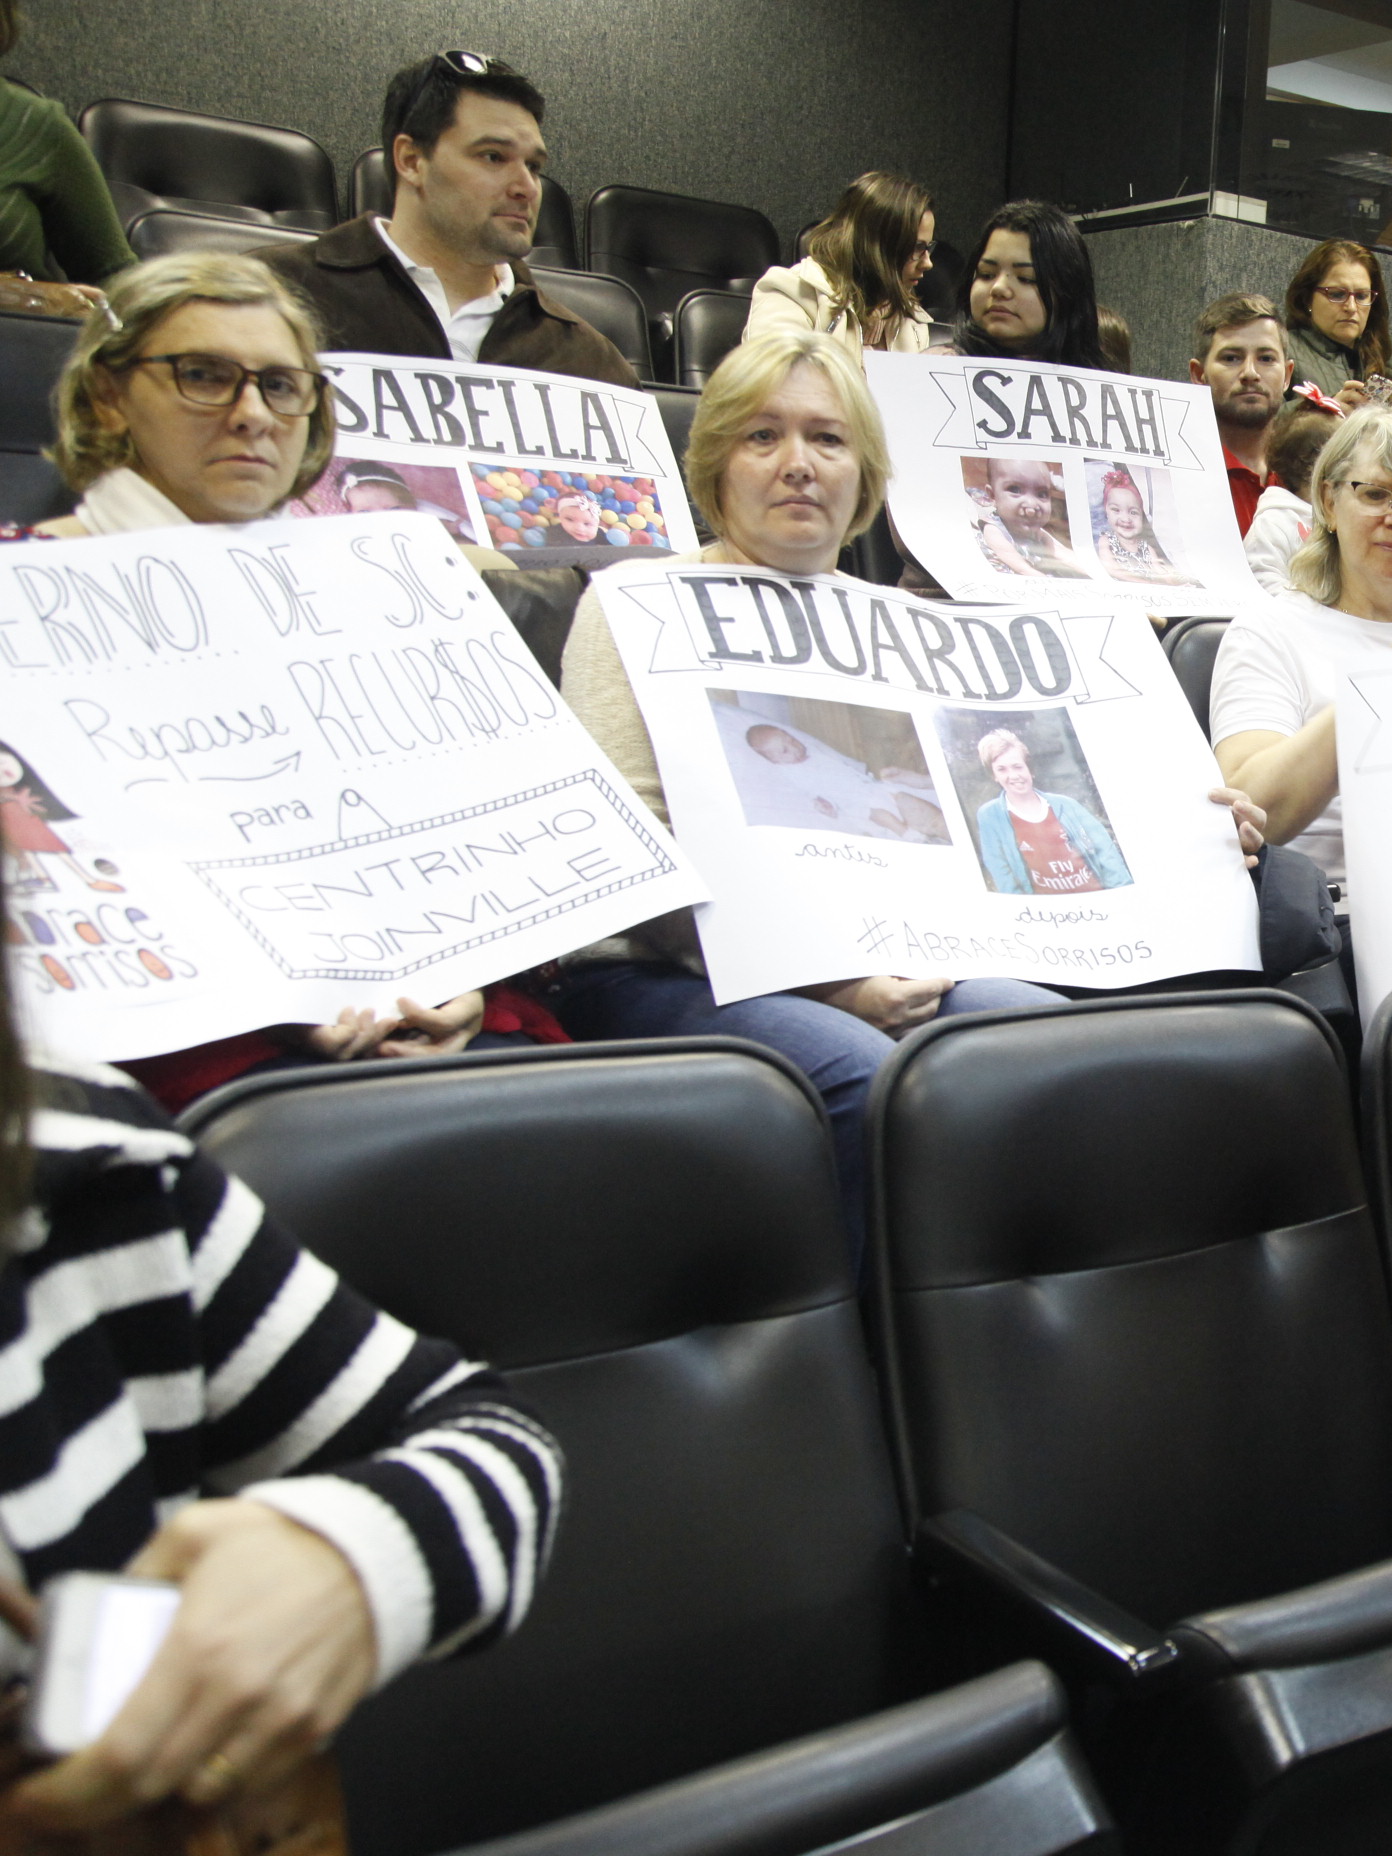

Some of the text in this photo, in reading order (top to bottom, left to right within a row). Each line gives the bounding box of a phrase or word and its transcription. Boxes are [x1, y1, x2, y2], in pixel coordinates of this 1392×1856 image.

[323, 366, 628, 465] SABELLA
[972, 369, 1166, 457] SARAH
[0, 556, 209, 669] ERNO
[227, 543, 343, 637] DE
[679, 576, 1072, 701] EDUARDO
[64, 699, 290, 783] Repasse
[230, 799, 313, 843] para
[239, 808, 597, 912] CENTRINHO
[794, 840, 888, 868] antes
[308, 847, 623, 963] JOINVILLE
[1048, 860, 1075, 874] Fly
[1015, 905, 1109, 928] depois
